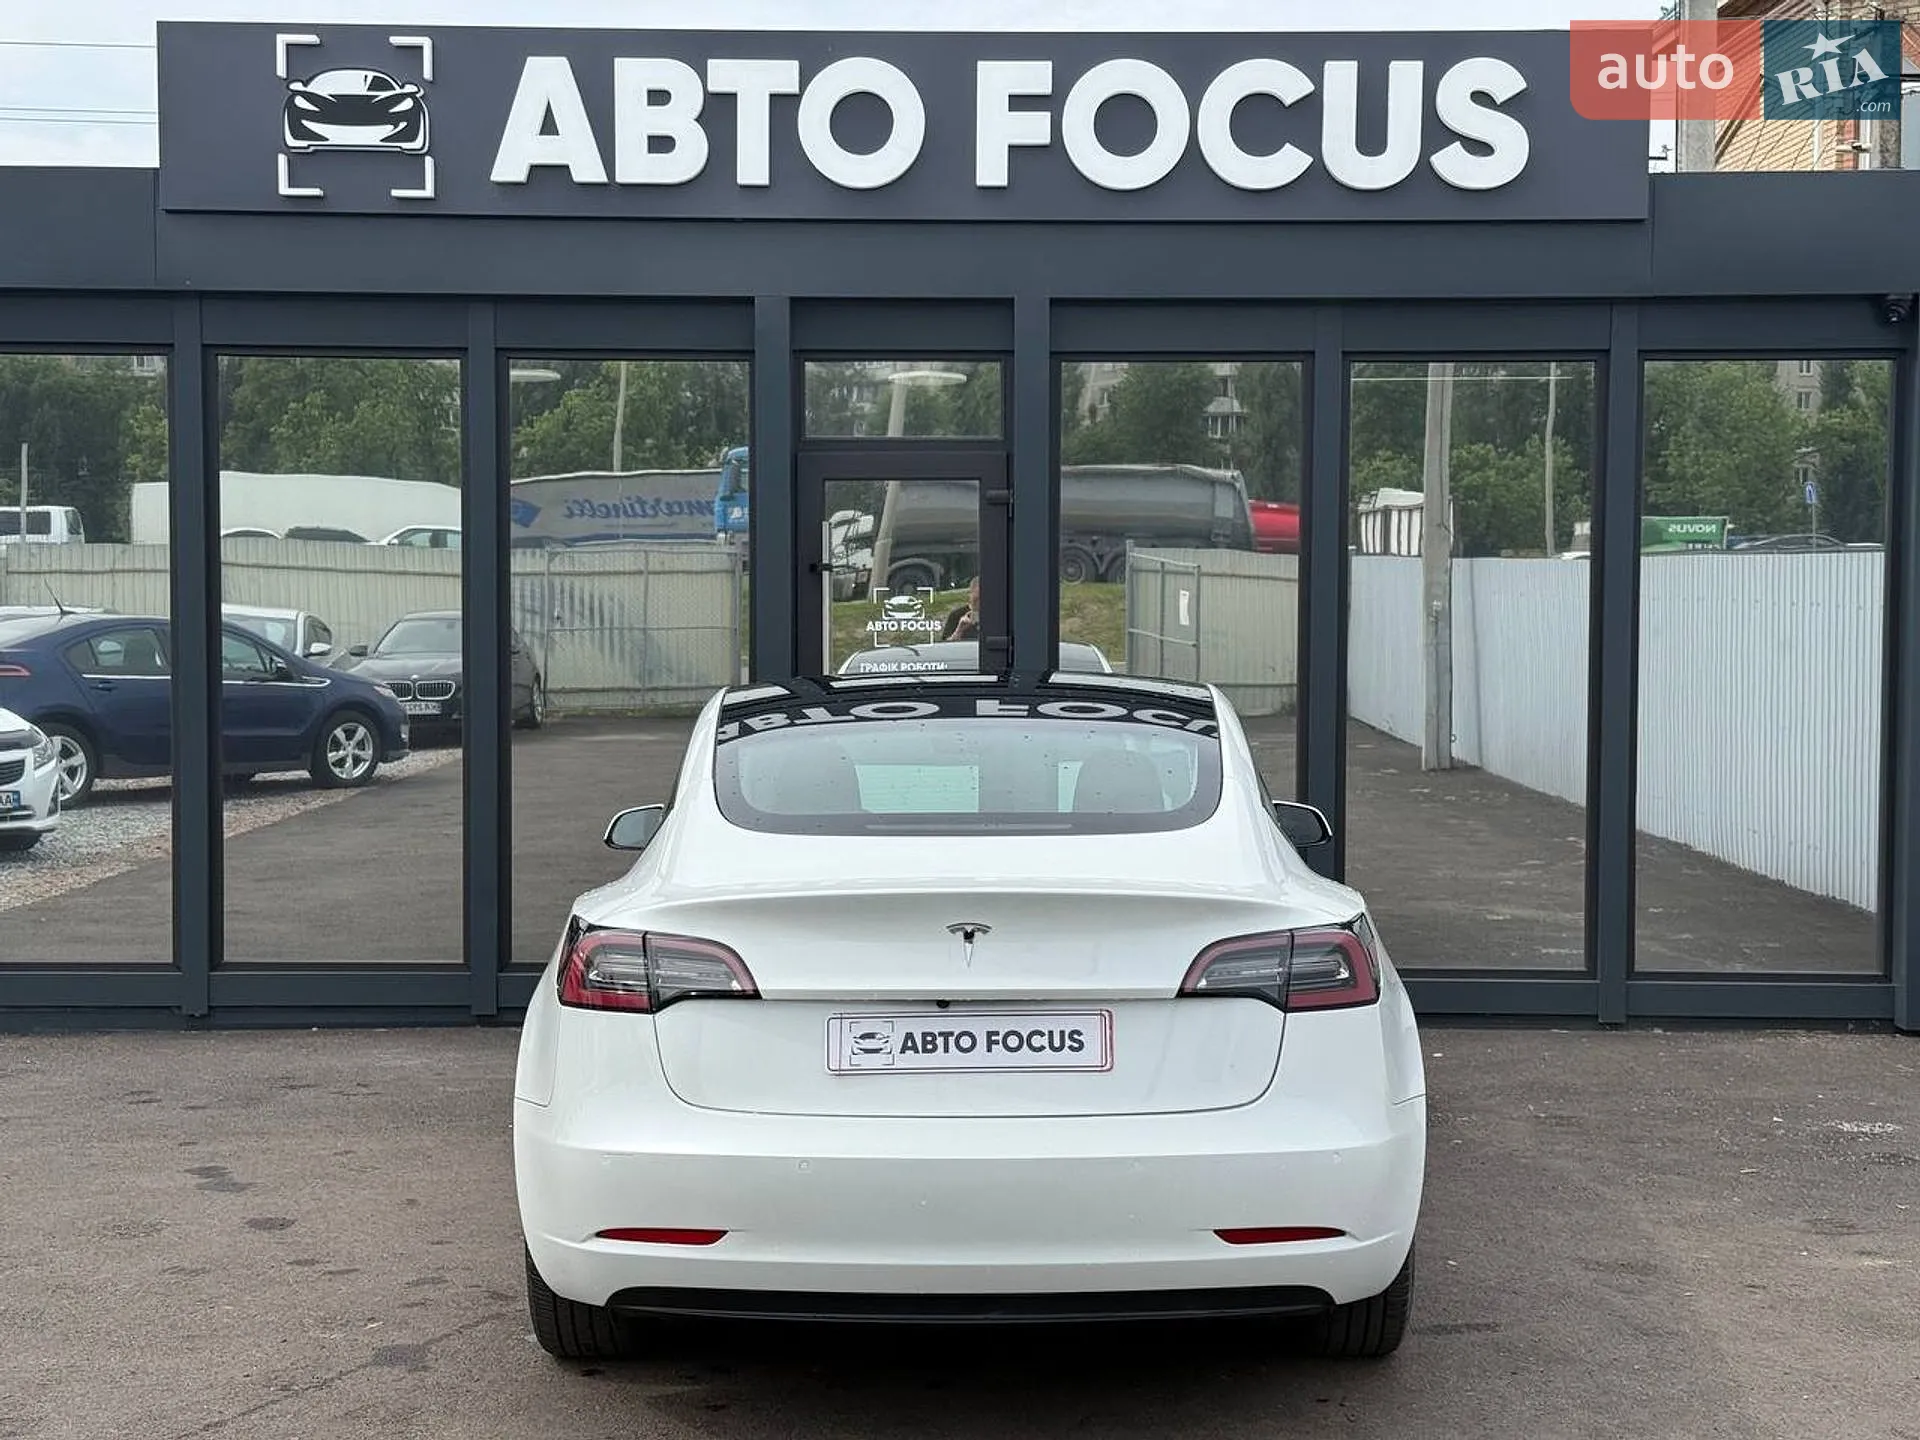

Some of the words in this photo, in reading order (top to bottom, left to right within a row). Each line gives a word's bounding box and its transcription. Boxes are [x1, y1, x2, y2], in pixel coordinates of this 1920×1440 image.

[490, 56, 926, 189] АВТО
[975, 57, 1531, 192] FOCUS
[865, 620, 898, 632] АВТО
[901, 620, 942, 631] FOCUS
[860, 662, 898, 673] ГРАФІК
[899, 1031, 978, 1055] АВТО
[985, 1029, 1086, 1053] FOCUS
